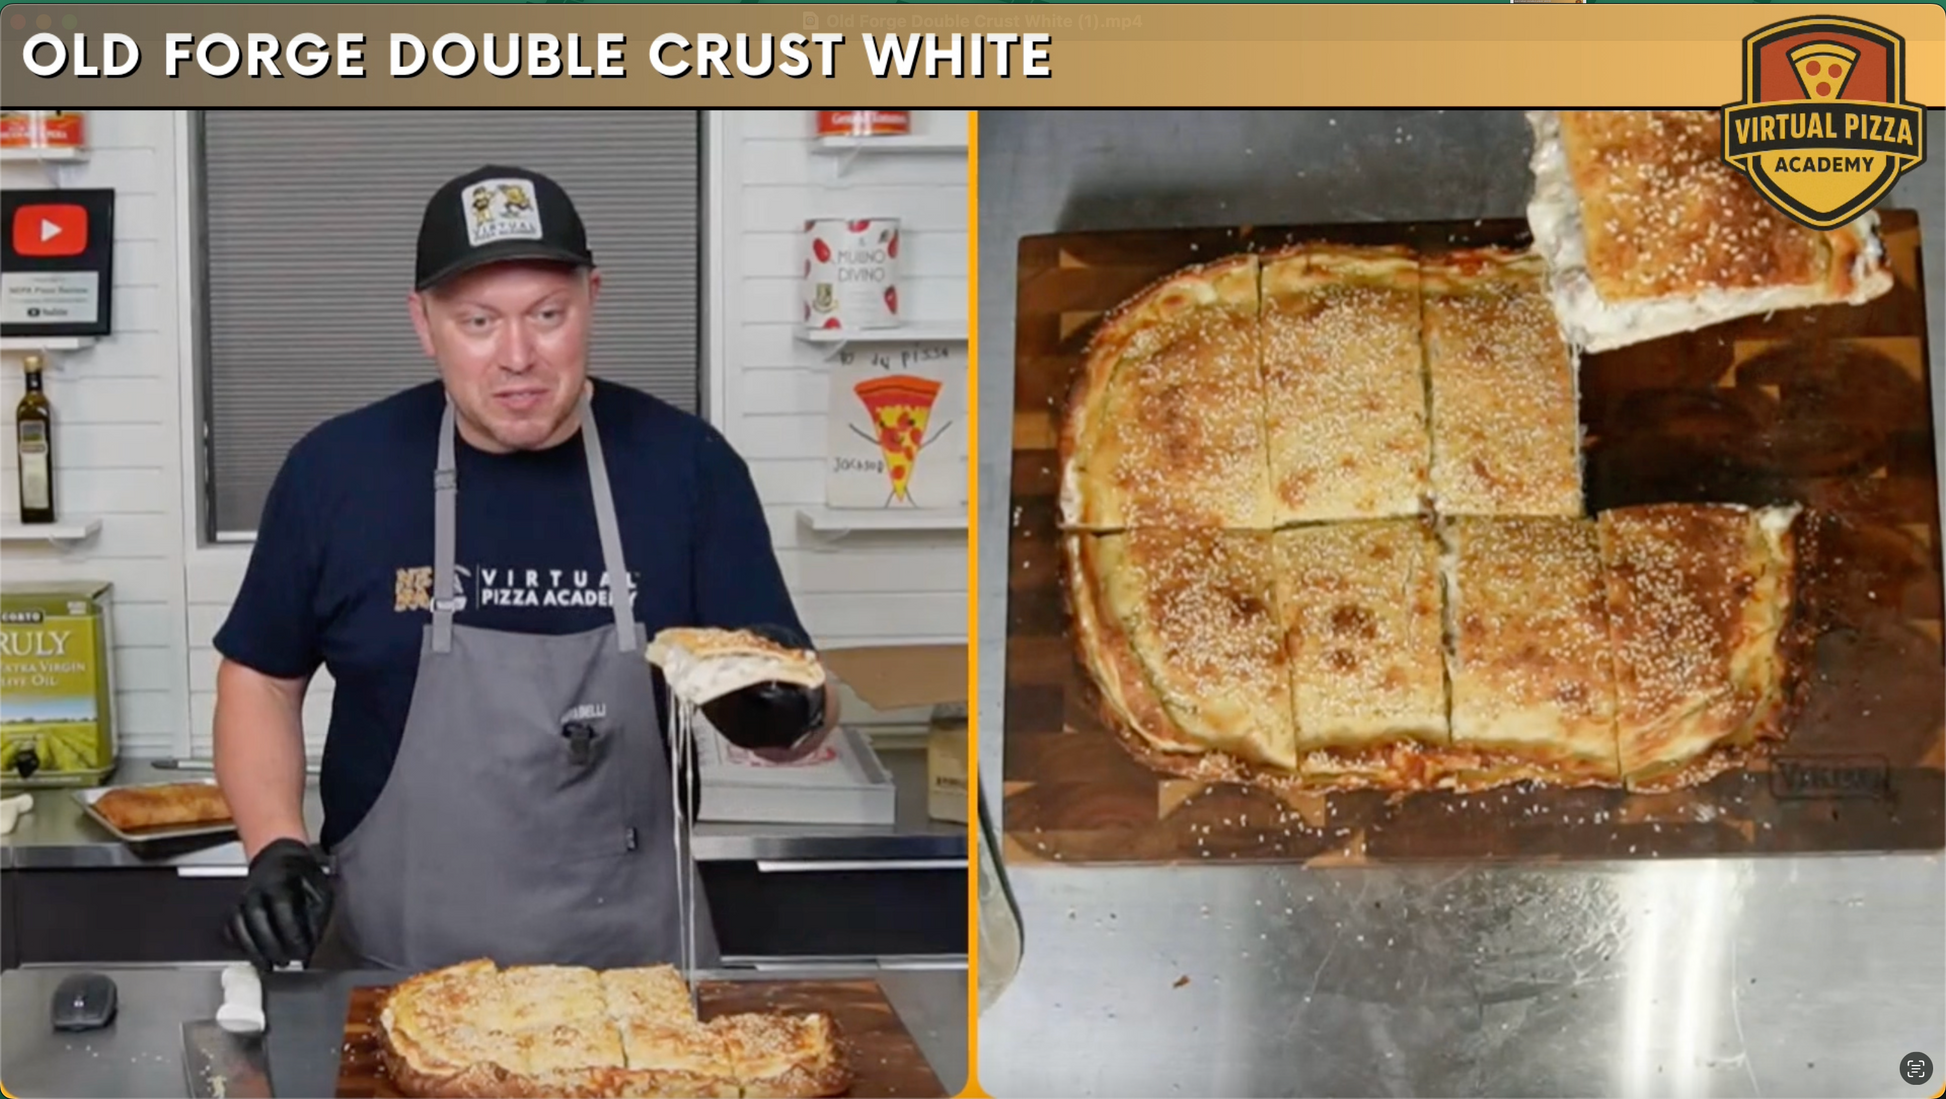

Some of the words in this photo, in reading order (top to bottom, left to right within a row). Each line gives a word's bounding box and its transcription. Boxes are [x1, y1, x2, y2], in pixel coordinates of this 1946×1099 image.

[838, 267, 886, 282] DIVINO
[482, 590, 539, 606] PIZZA
[543, 590, 637, 606] ACADEY
